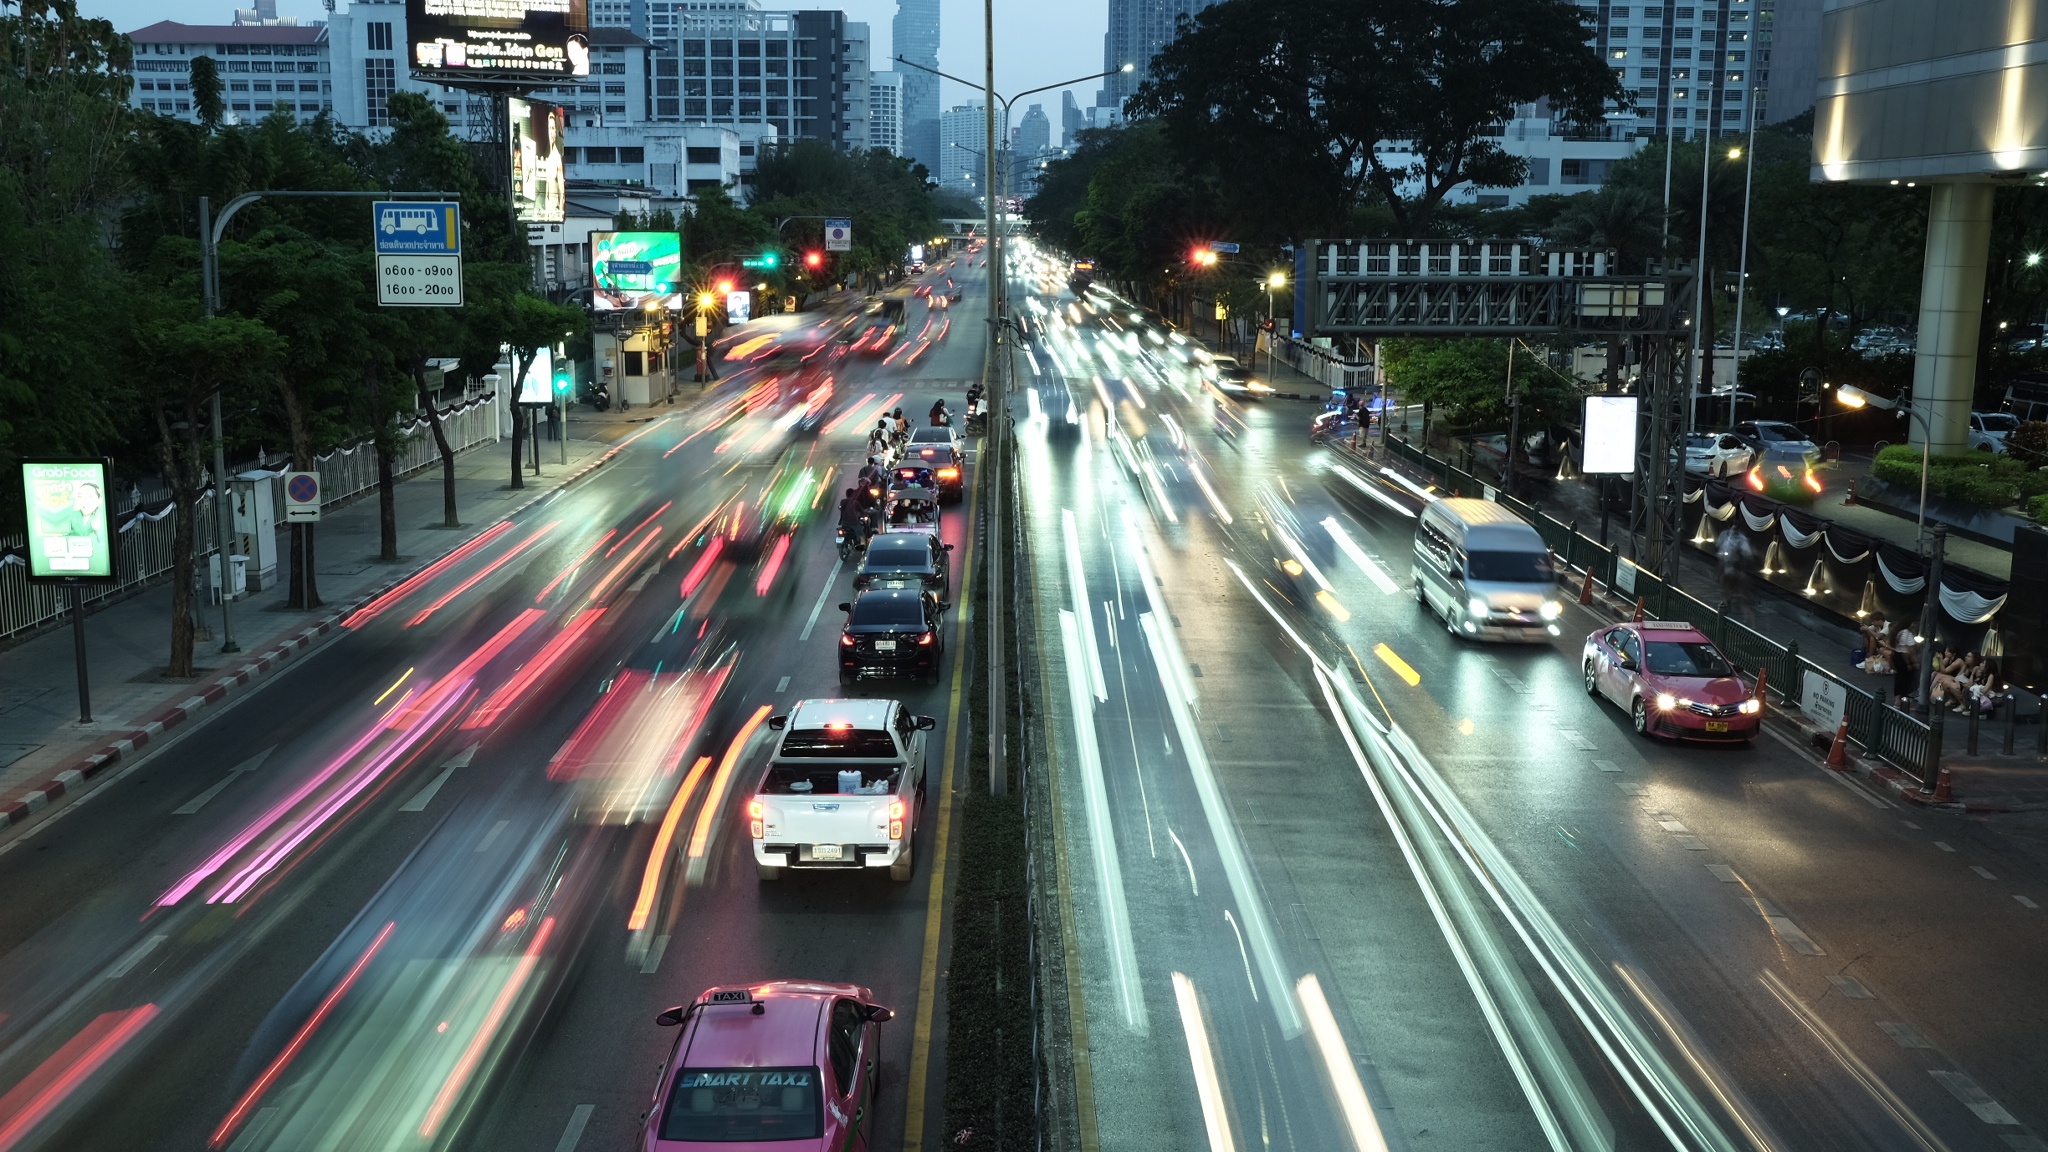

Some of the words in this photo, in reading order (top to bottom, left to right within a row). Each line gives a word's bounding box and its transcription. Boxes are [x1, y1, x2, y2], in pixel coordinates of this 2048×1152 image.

[535, 44, 563, 58] Gen
[32, 466, 96, 478] GrabFood
[1812, 691, 1819, 700] NO
[1819, 693, 1835, 709] PARKING
[715, 991, 745, 1001] TAXI
[680, 1072, 753, 1088] SMART
[760, 1072, 812, 1087] TAXI
